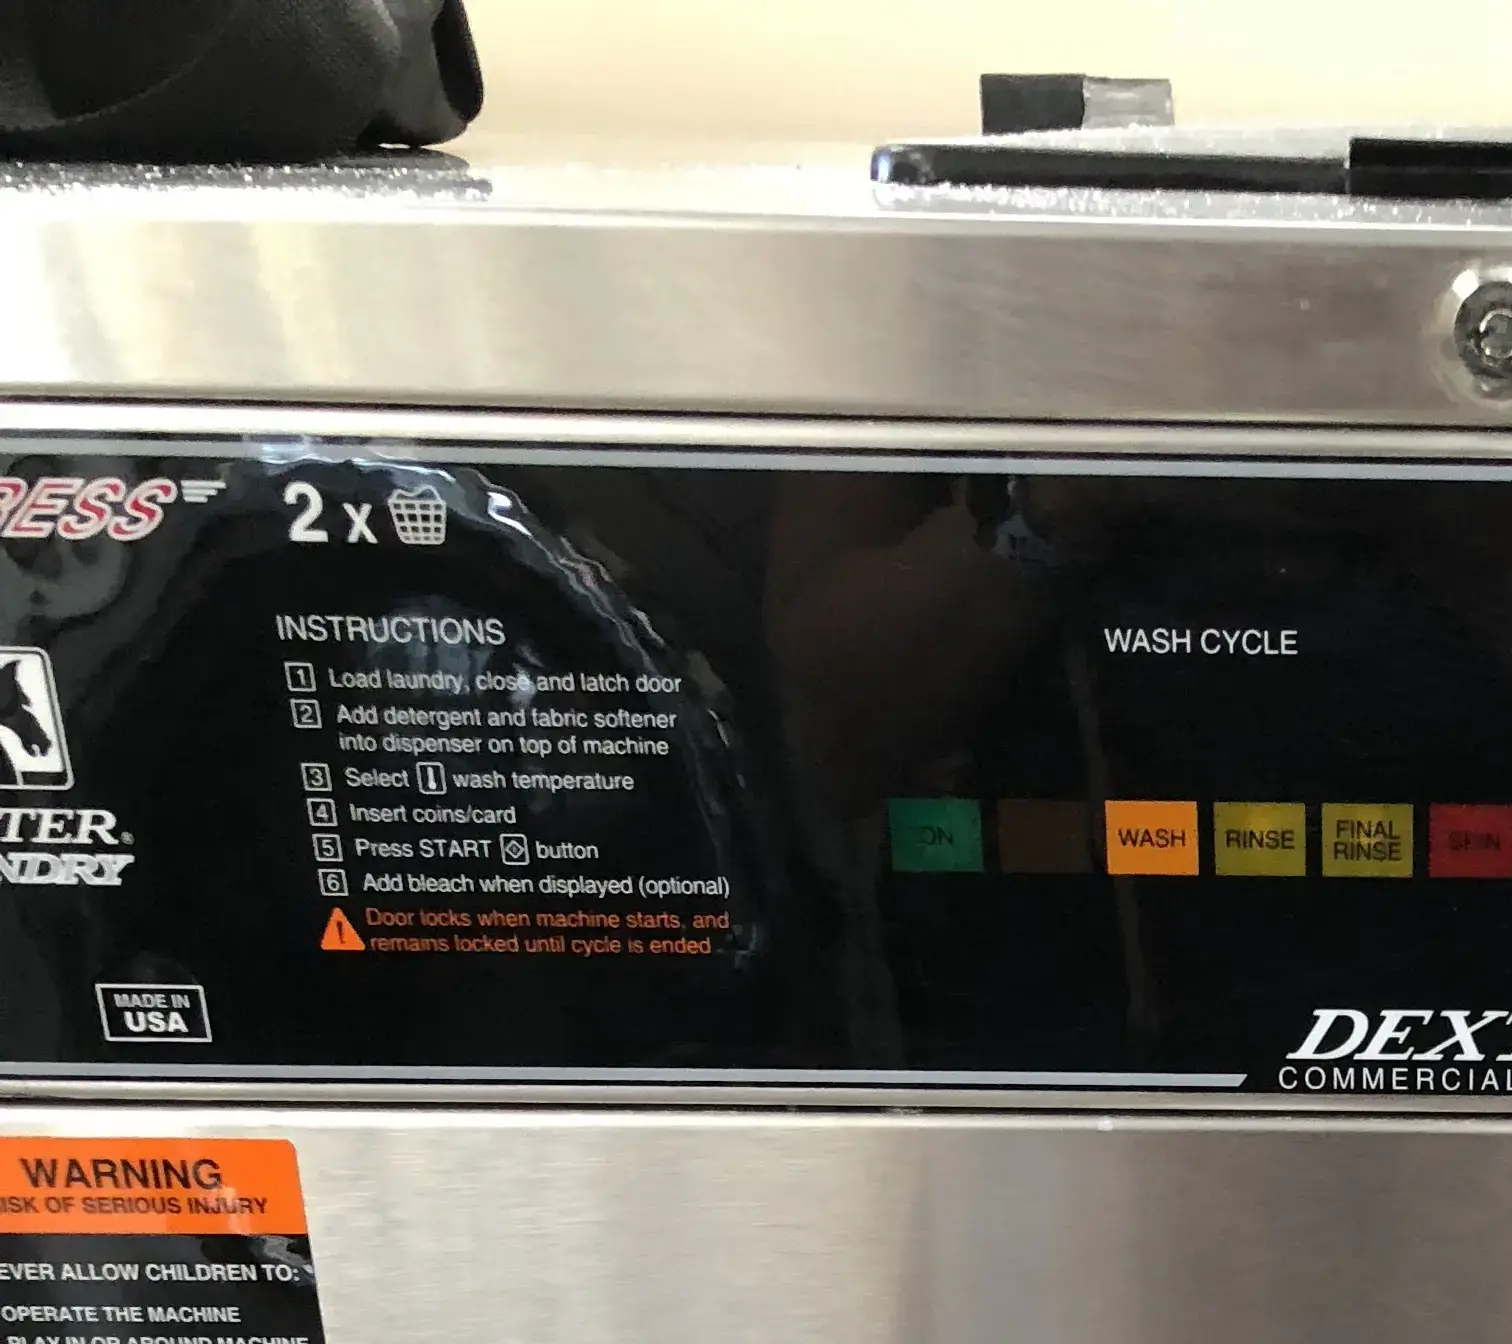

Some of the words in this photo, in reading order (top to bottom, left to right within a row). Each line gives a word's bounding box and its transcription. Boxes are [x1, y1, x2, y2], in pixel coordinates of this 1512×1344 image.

[284, 480, 329, 542] 2
[276, 615, 506, 645] INSTRUCTIONS
[1104, 628, 1192, 654] WASH
[1200, 629, 1298, 655] CYCLE
[328, 668, 382, 689] Load
[387, 669, 470, 695] laundry,
[475, 671, 530, 691] close
[537, 672, 575, 692] and
[580, 672, 630, 692] latch
[635, 673, 682, 693] door
[336, 704, 378, 725] Add
[384, 706, 482, 731] detergent
[487, 708, 526, 727] and
[532, 708, 588, 728] fabric
[594, 709, 677, 729] softener
[338, 732, 378, 751] into
[383, 733, 482, 757] dispenser
[488, 737, 514, 753] on
[519, 737, 552, 758] top
[557, 736, 577, 754] of
[583, 736, 670, 755] machine
[344, 767, 410, 787] Select
[452, 770, 507, 789] wash
[511, 771, 635, 793] temperature
[349, 803, 408, 823] Insert
[412, 805, 517, 824] coins/card
[1117, 828, 1186, 848] WASH
[1225, 829, 1295, 850] RINSE
[1336, 819, 1401, 840] FINAL
[354, 838, 414, 858] Press
[418, 838, 492, 859] START
[535, 841, 599, 859] button
[1333, 841, 1403, 862] RINSE
[362, 873, 404, 893] Add
[407, 873, 475, 894] bleach
[478, 875, 534, 894] when
[538, 875, 633, 899] displayed
[638, 876, 730, 899] (optional)
[365, 907, 415, 927] Door
[420, 909, 472, 927] locks
[476, 910, 532, 928] when
[536, 910, 620, 929] machine
[692, 912, 730, 929] and
[370, 936, 450, 952] remains
[454, 935, 519, 953] locked
[524, 936, 566, 953] until
[571, 937, 621, 958] cycle
[627, 937, 644, 954] is
[649, 937, 712, 955] ended
[113, 993, 169, 1009] MADE
[171, 994, 191, 1009] IN
[123, 1011, 189, 1033] USA
[20, 1158, 222, 1189] WARNING
[45, 1197, 76, 1214] OF
[82, 1197, 182, 1214] SERIOUS
[188, 1197, 268, 1214] INJURY
[60, 1263, 140, 1281] ALLOW
[145, 1263, 258, 1281] CHILDREN
[261, 1264, 301, 1282] TO:
[1, 1305, 100, 1323] OPERATE
[101, 1306, 145, 1323] THE
[147, 1306, 242, 1323] MACHINE
